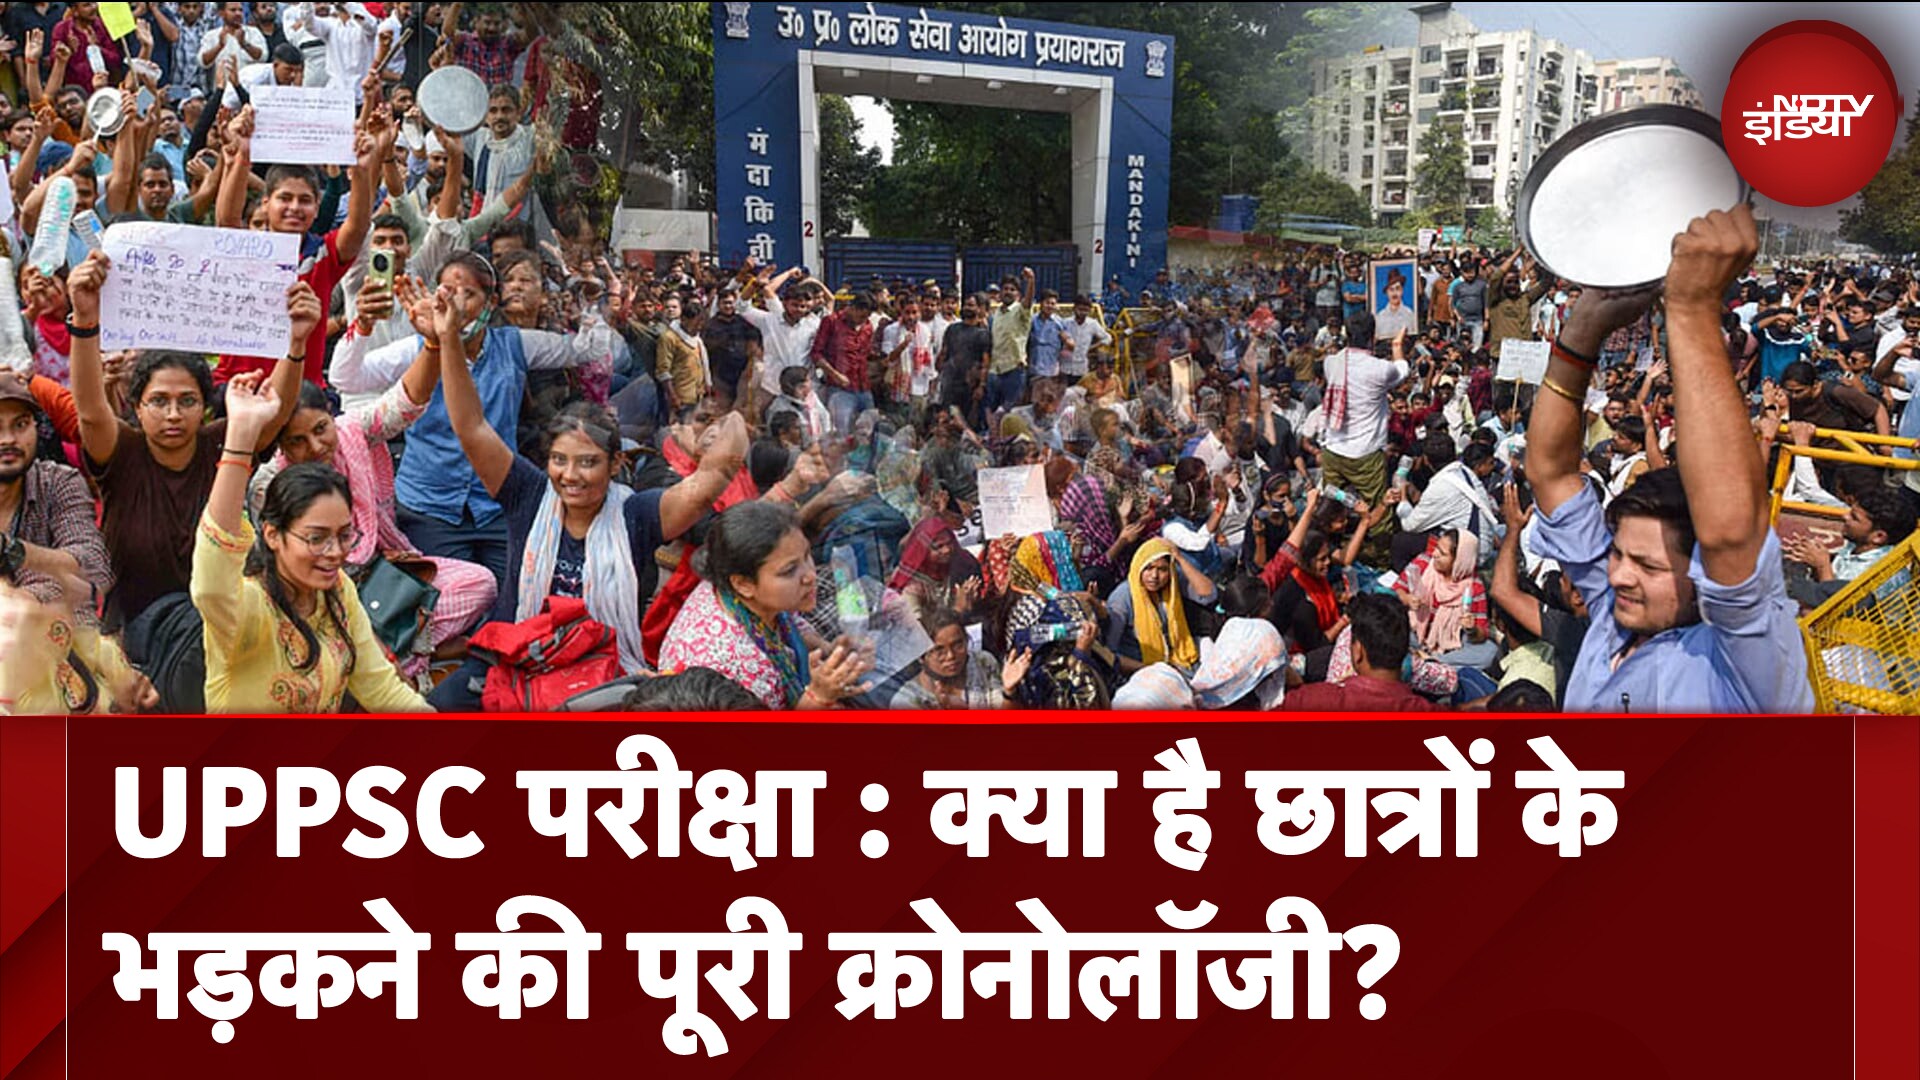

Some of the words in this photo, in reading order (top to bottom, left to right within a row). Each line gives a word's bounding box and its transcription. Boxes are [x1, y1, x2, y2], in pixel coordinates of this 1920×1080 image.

[776, 6, 805, 39] उ०
[813, 9, 841, 47] प्र०
[848, 2, 900, 46] लोक
[908, 8, 953, 51] सेवा
[958, 17, 1028, 58] आयोग
[1034, 31, 1126, 68] प्रयागराज
[804, 221, 814, 238] 2
[1126, 154, 1144, 268] MANDAKINI
[1094, 239, 1104, 254] 2
